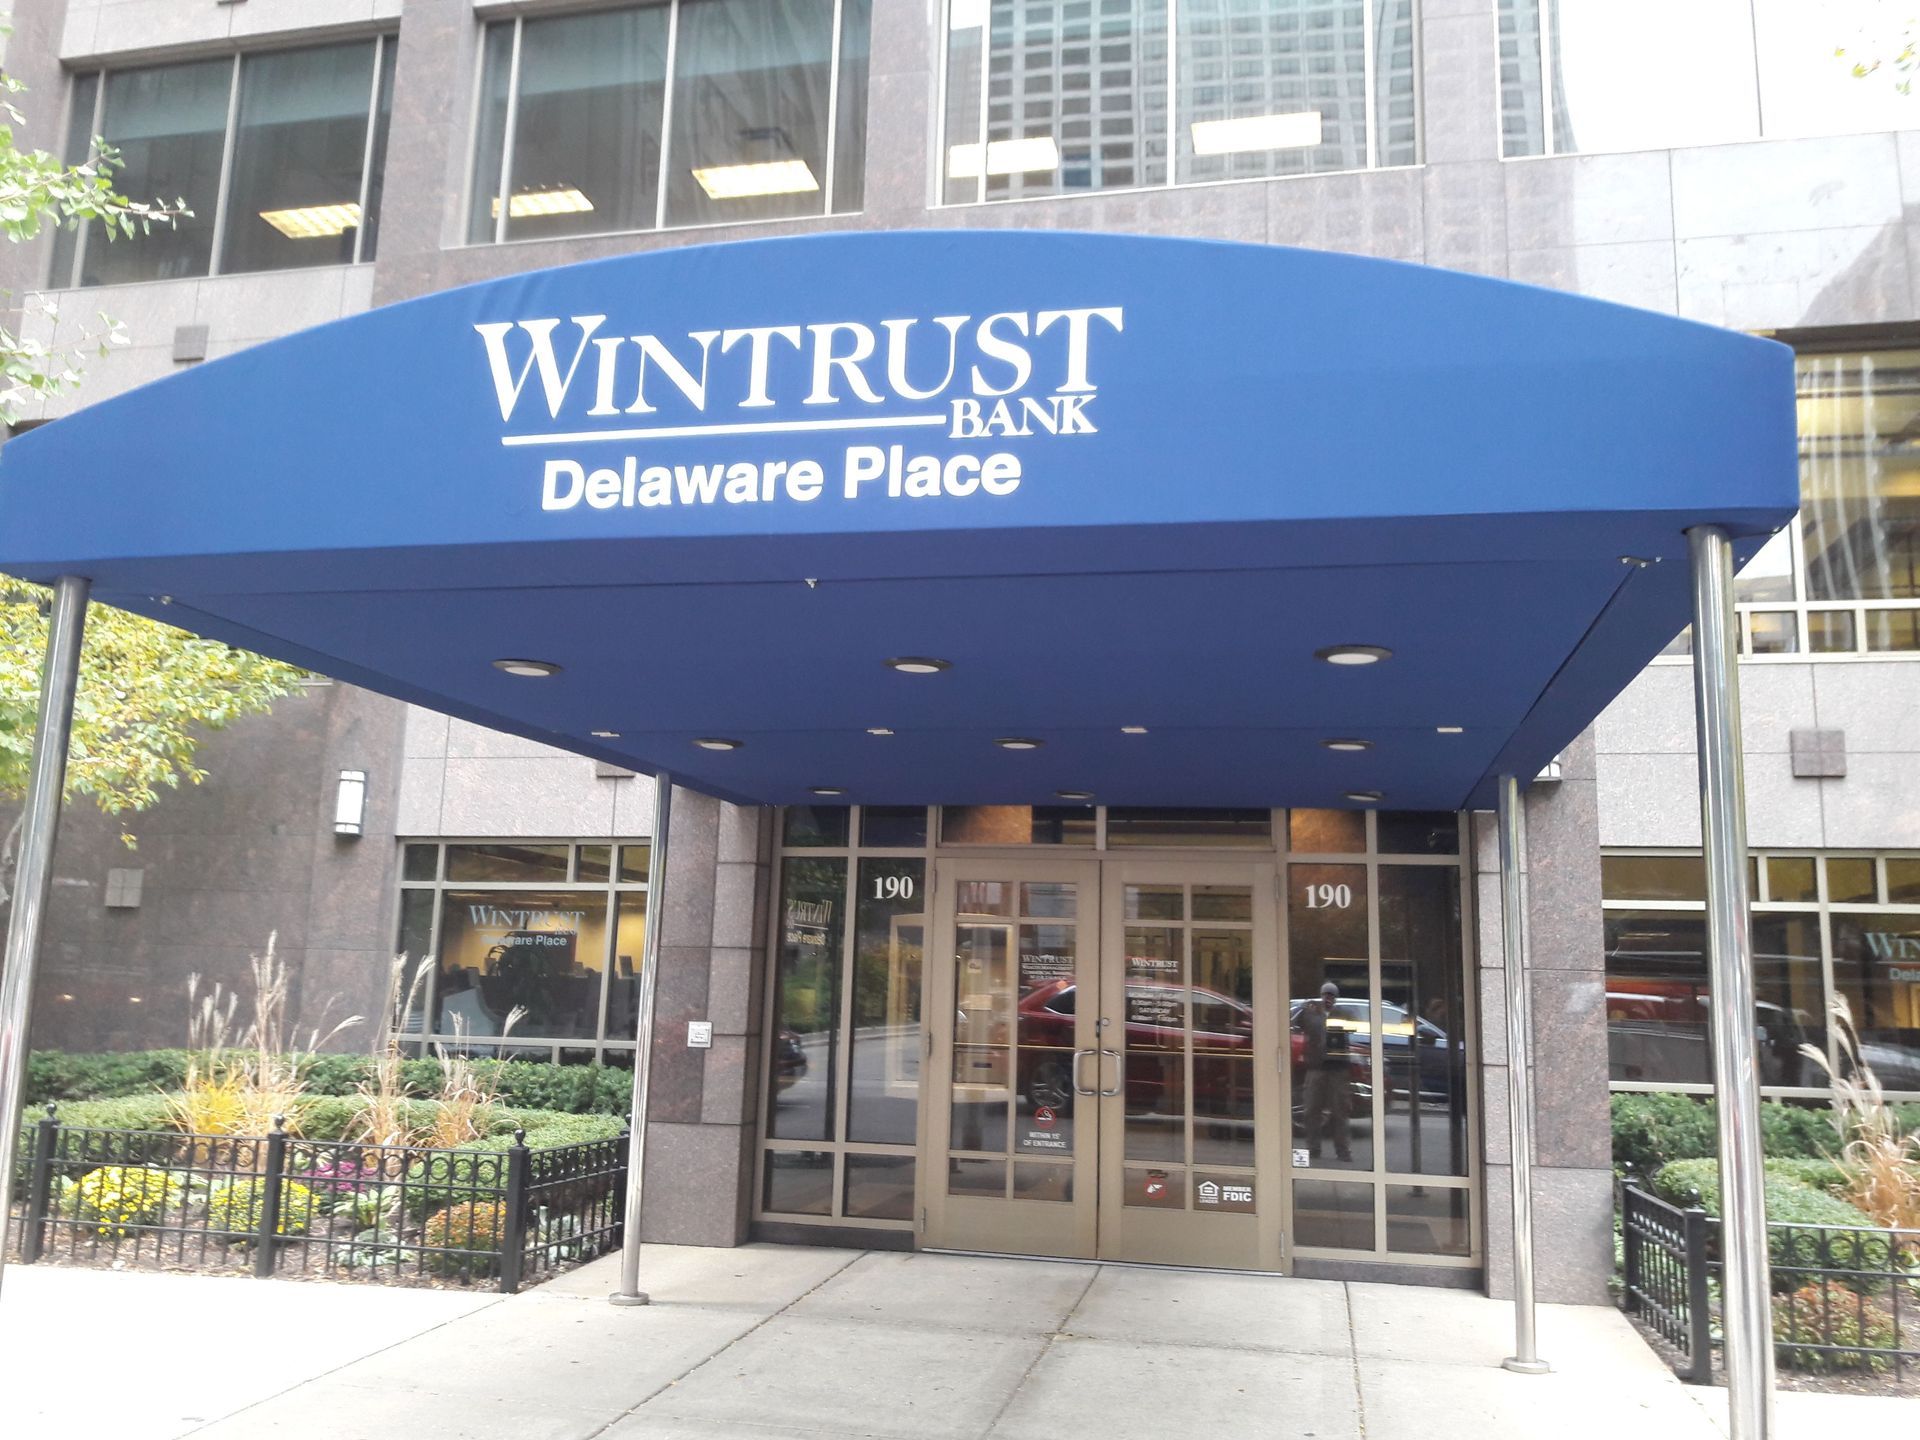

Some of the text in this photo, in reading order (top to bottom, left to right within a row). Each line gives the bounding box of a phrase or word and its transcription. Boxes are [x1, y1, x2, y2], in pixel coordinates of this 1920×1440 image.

[474, 307, 1124, 422] WINTRUST
[949, 395, 1098, 438] BANK
[542, 445, 1022, 511] Delaware Place
[874, 876, 914, 899] 190
[1304, 884, 1351, 909] 190
[535, 935, 568, 946] Place
[1022, 954, 1074, 963] WINTRUST
[1131, 957, 1178, 968] WINTRUST
[1033, 1140, 1067, 1149] ENTRANCE
[1223, 1191, 1253, 1202] FDIC
